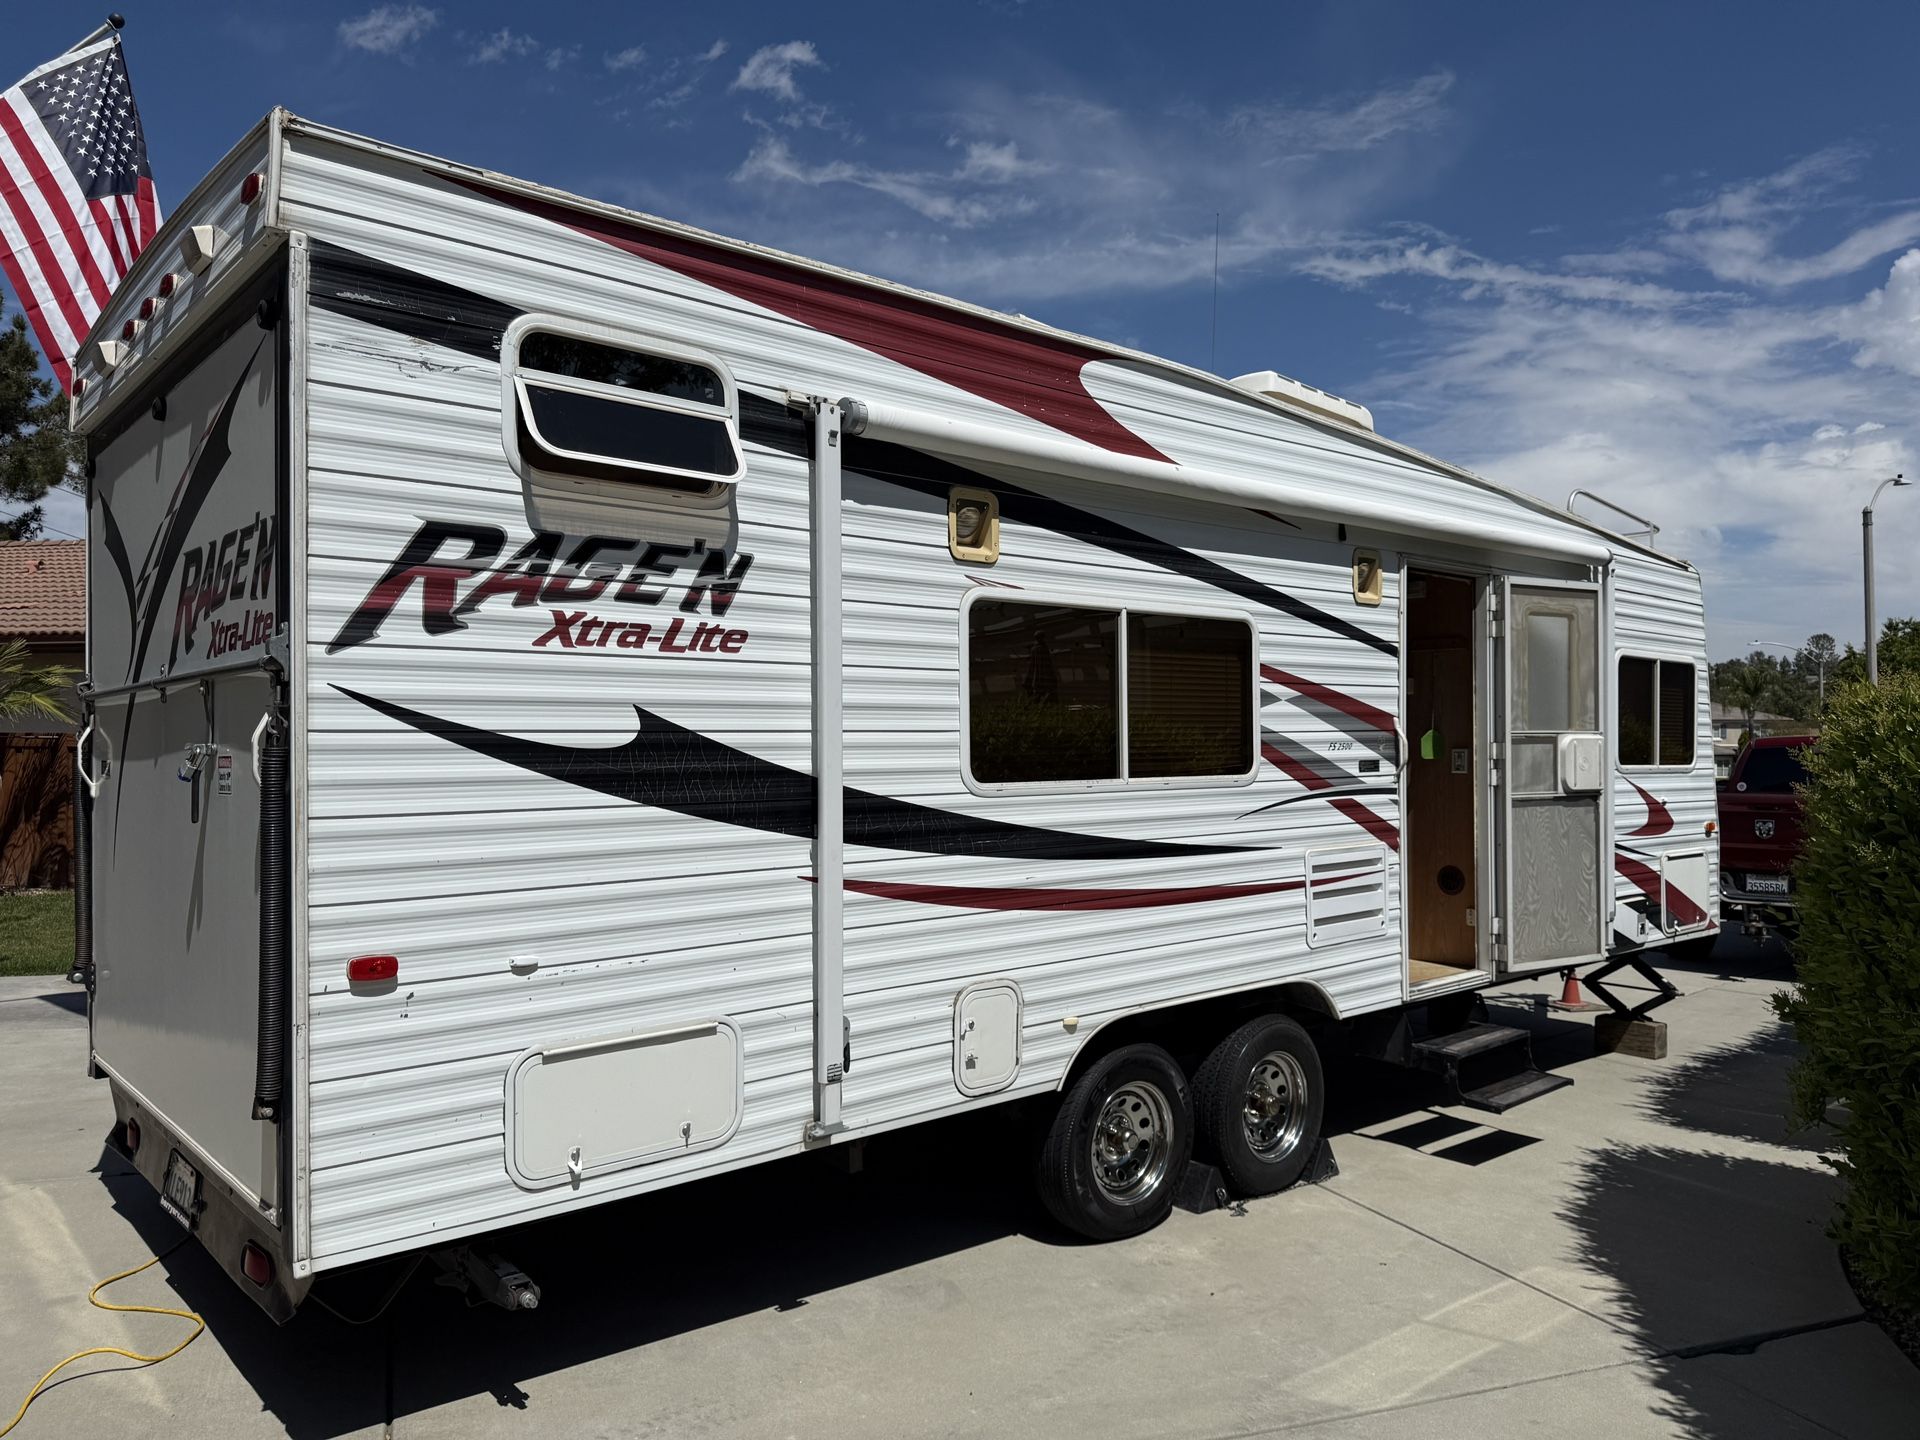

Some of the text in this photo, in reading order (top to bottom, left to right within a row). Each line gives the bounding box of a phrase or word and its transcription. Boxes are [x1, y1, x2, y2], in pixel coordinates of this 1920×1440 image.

[168, 511, 275, 676] RAGE'N
[325, 514, 755, 656] RAGE'N
[206, 608, 274, 660] Xtra-Lite
[531, 609, 749, 655] Xtra-Lite
[1328, 742, 1353, 751] FS 2500
